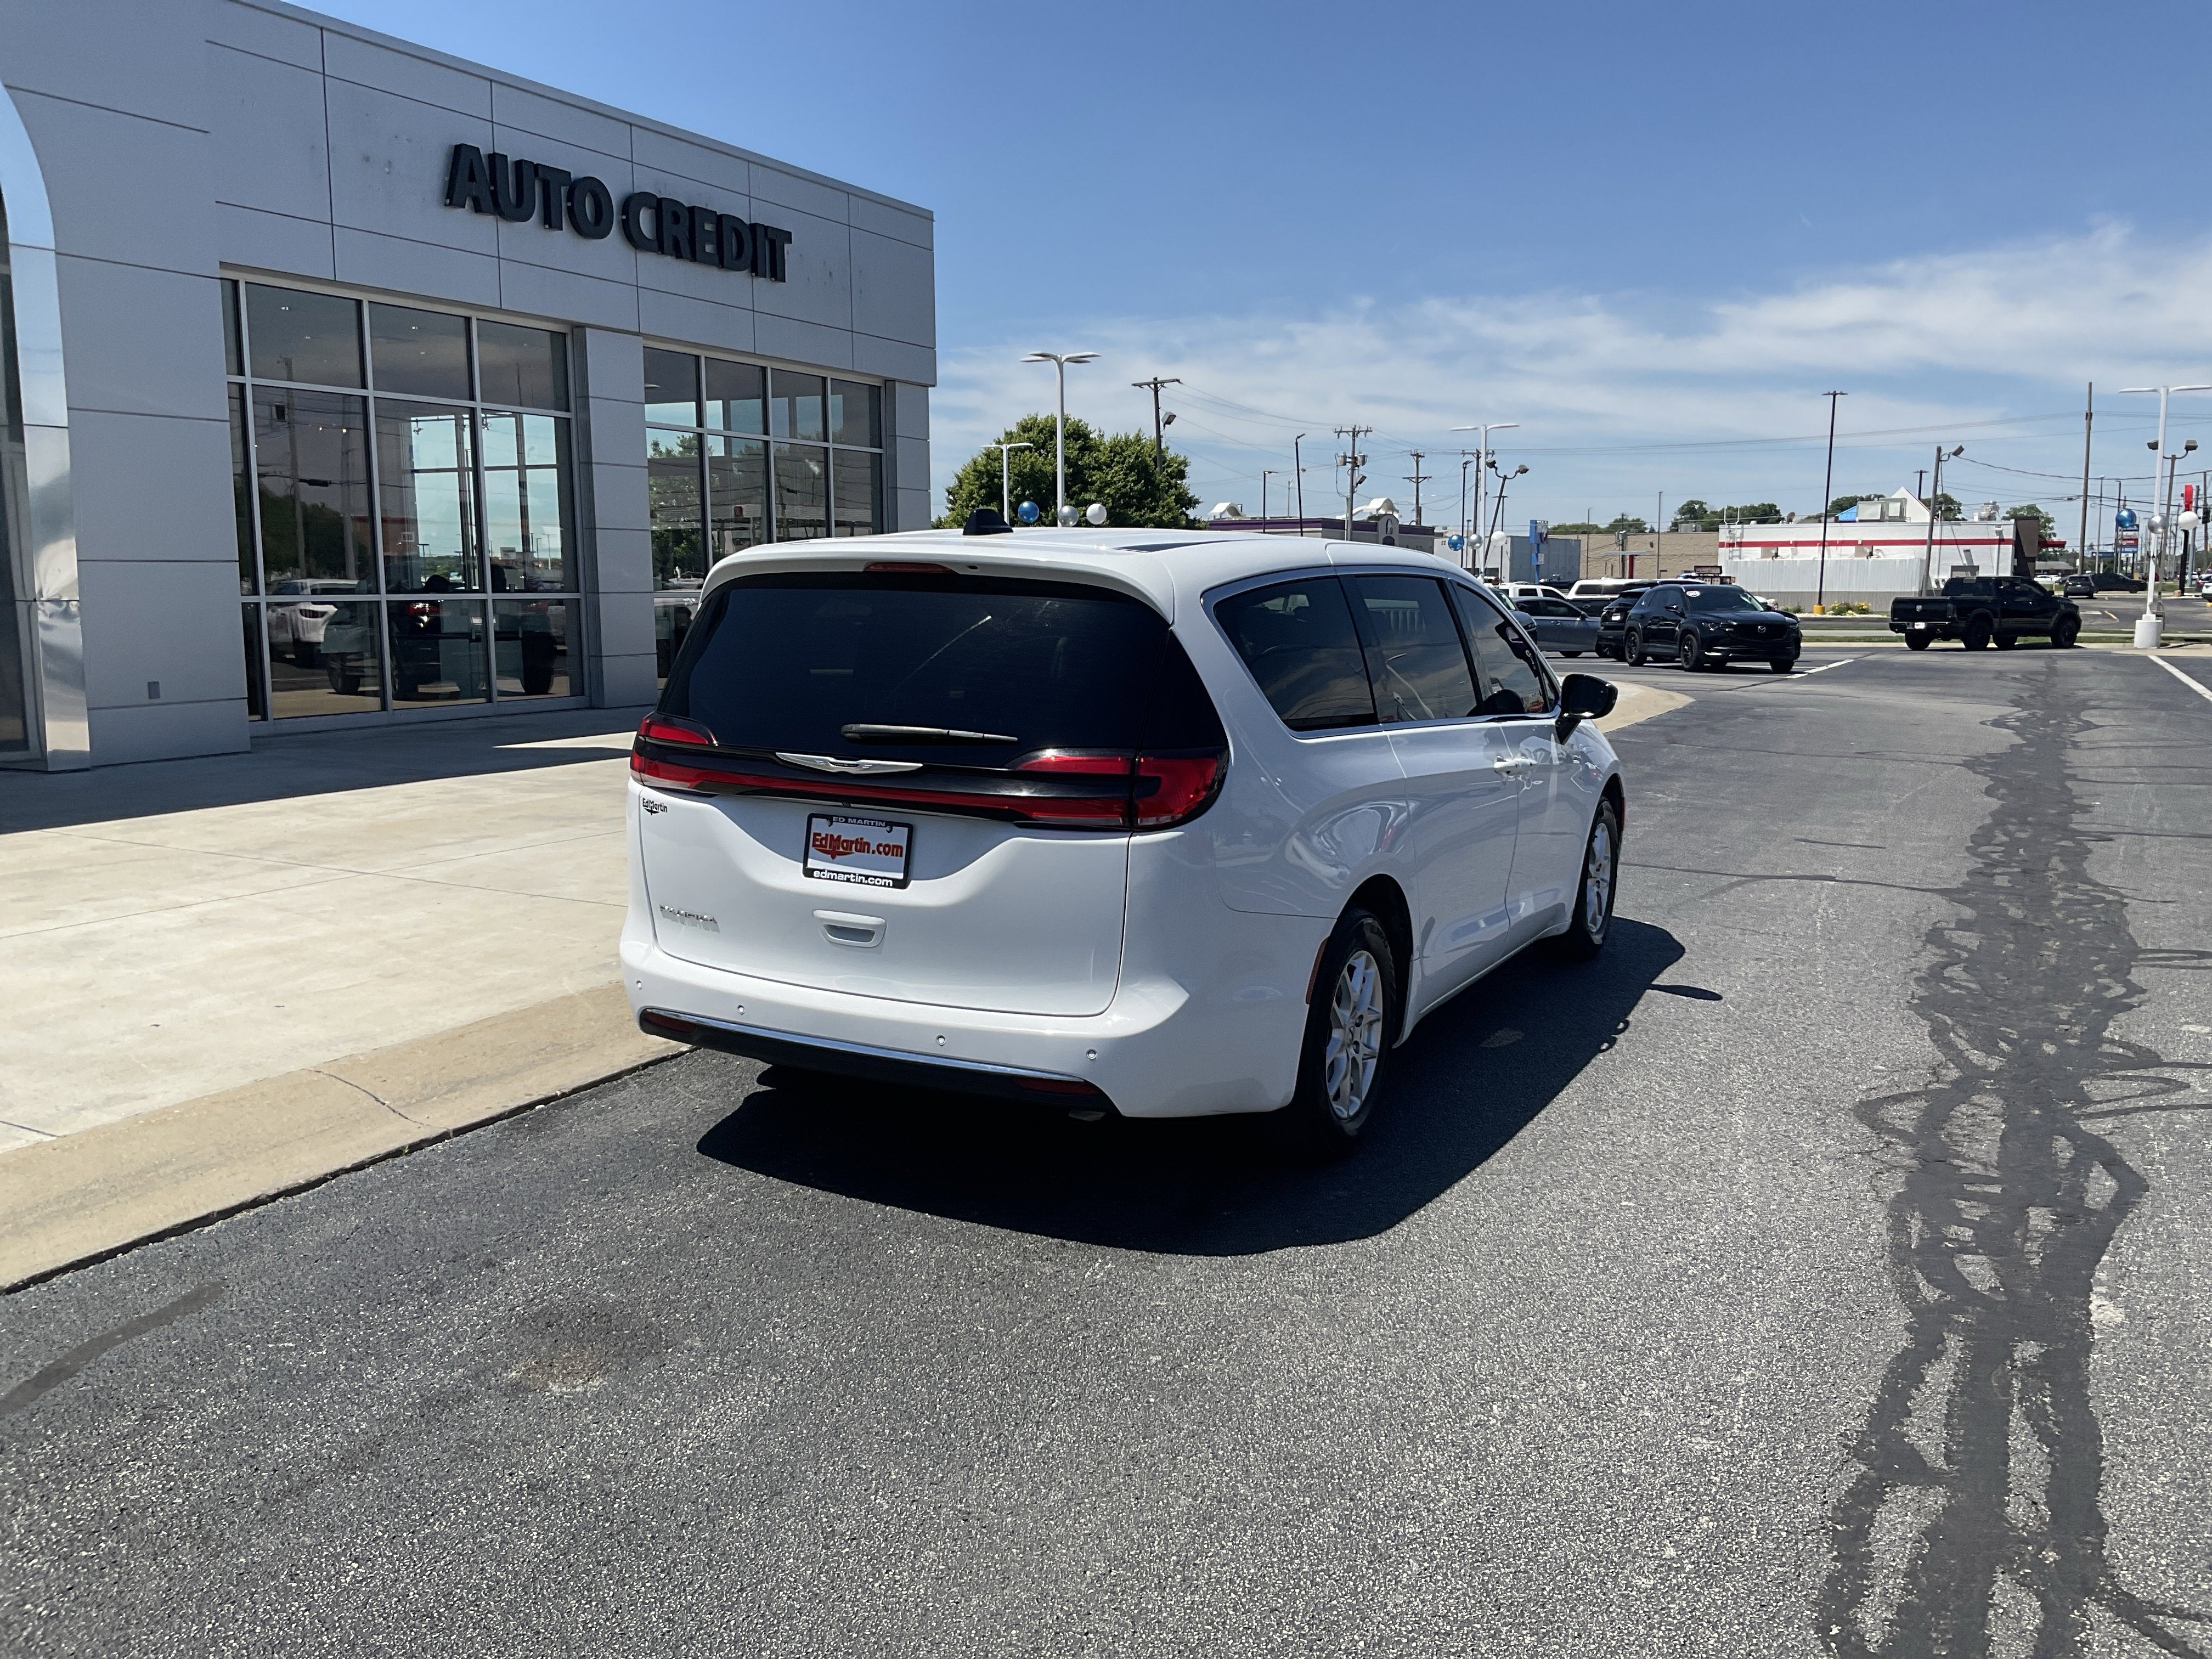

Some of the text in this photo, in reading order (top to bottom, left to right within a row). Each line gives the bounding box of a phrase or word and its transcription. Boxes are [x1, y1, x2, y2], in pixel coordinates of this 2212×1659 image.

[444, 143, 792, 283] AUTO CREDIT
[848, 818, 885, 827] MARTIN
[812, 832, 904, 857] EdMartin.com
[813, 868, 893, 887] edmartin.com
